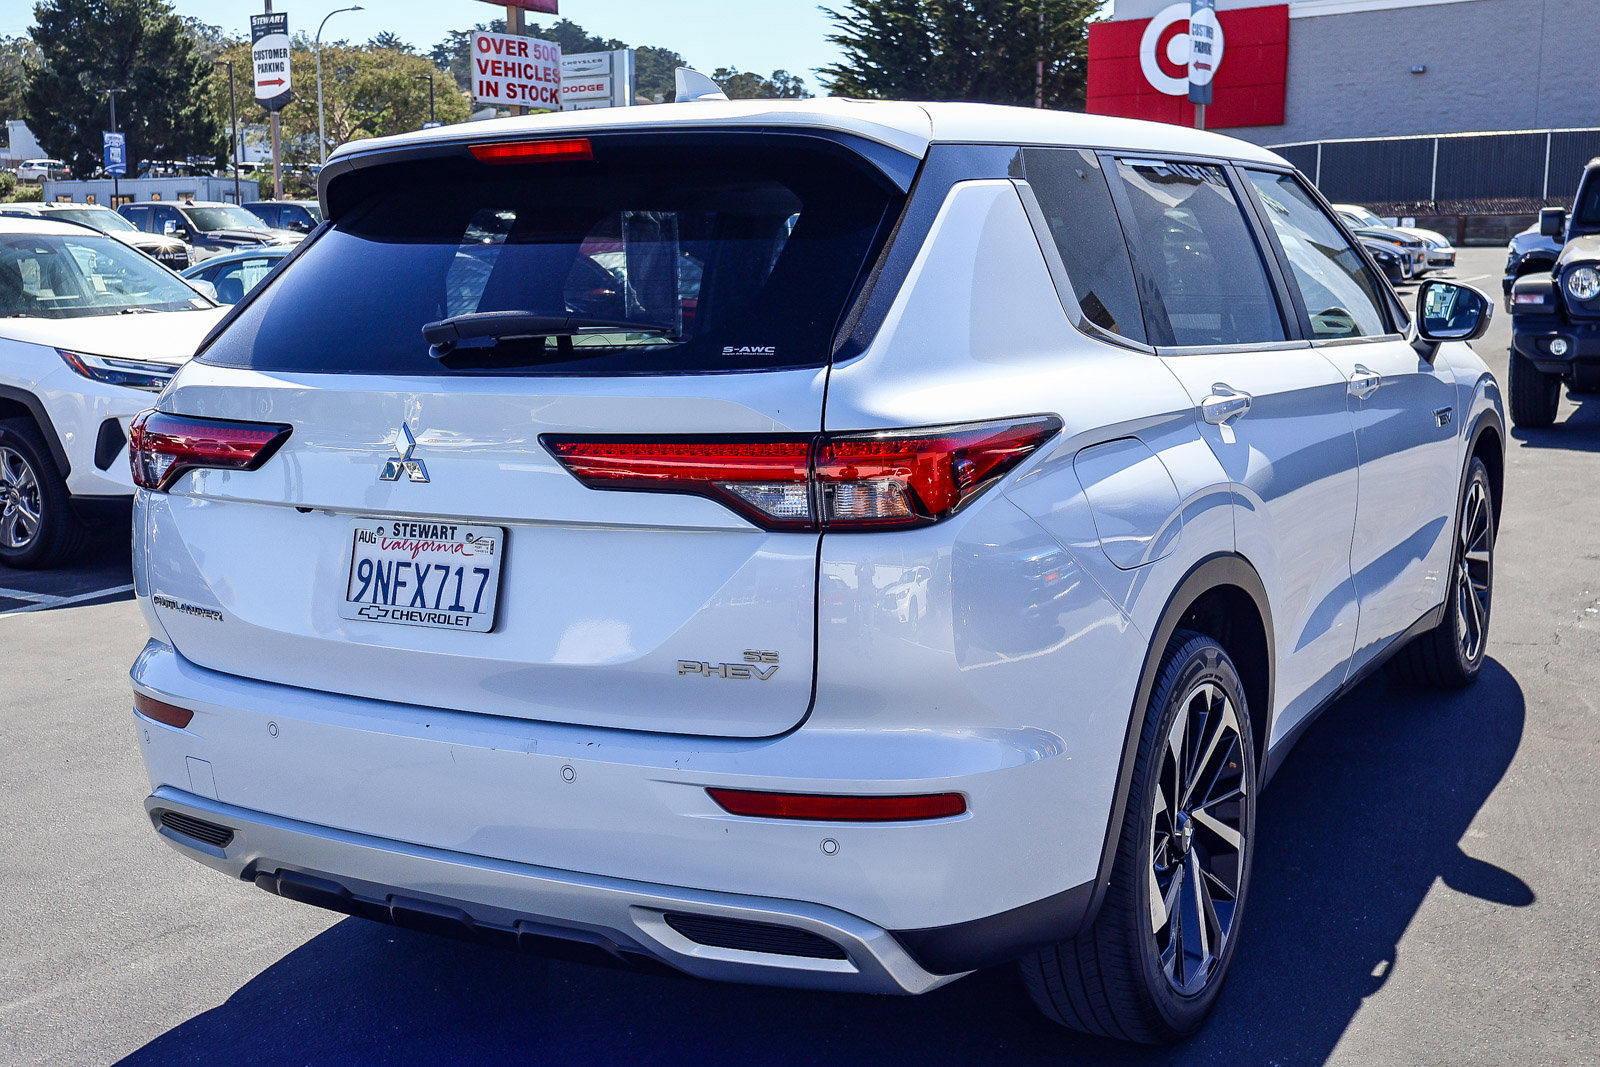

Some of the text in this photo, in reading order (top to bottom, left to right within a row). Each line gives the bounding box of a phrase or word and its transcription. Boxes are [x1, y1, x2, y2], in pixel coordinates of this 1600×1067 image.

[252, 15, 285, 26] STEWART
[254, 48, 288, 61] CUSTOMER
[477, 36, 558, 62] OVER 500
[258, 62, 285, 74] PARKING
[476, 58, 561, 84] VEHICLES
[562, 58, 603, 66] CHRYSLER
[478, 80, 560, 104] IN STOCK
[562, 84, 605, 93] DODGE
[358, 530, 377, 544] AUG
[392, 522, 458, 541] STEWART
[381, 537, 474, 559] California
[352, 558, 490, 613] 9NFX717
[153, 595, 224, 621] OUTLANDER
[391, 609, 472, 627] CHEVROLET
[677, 659, 780, 681] PHEV
